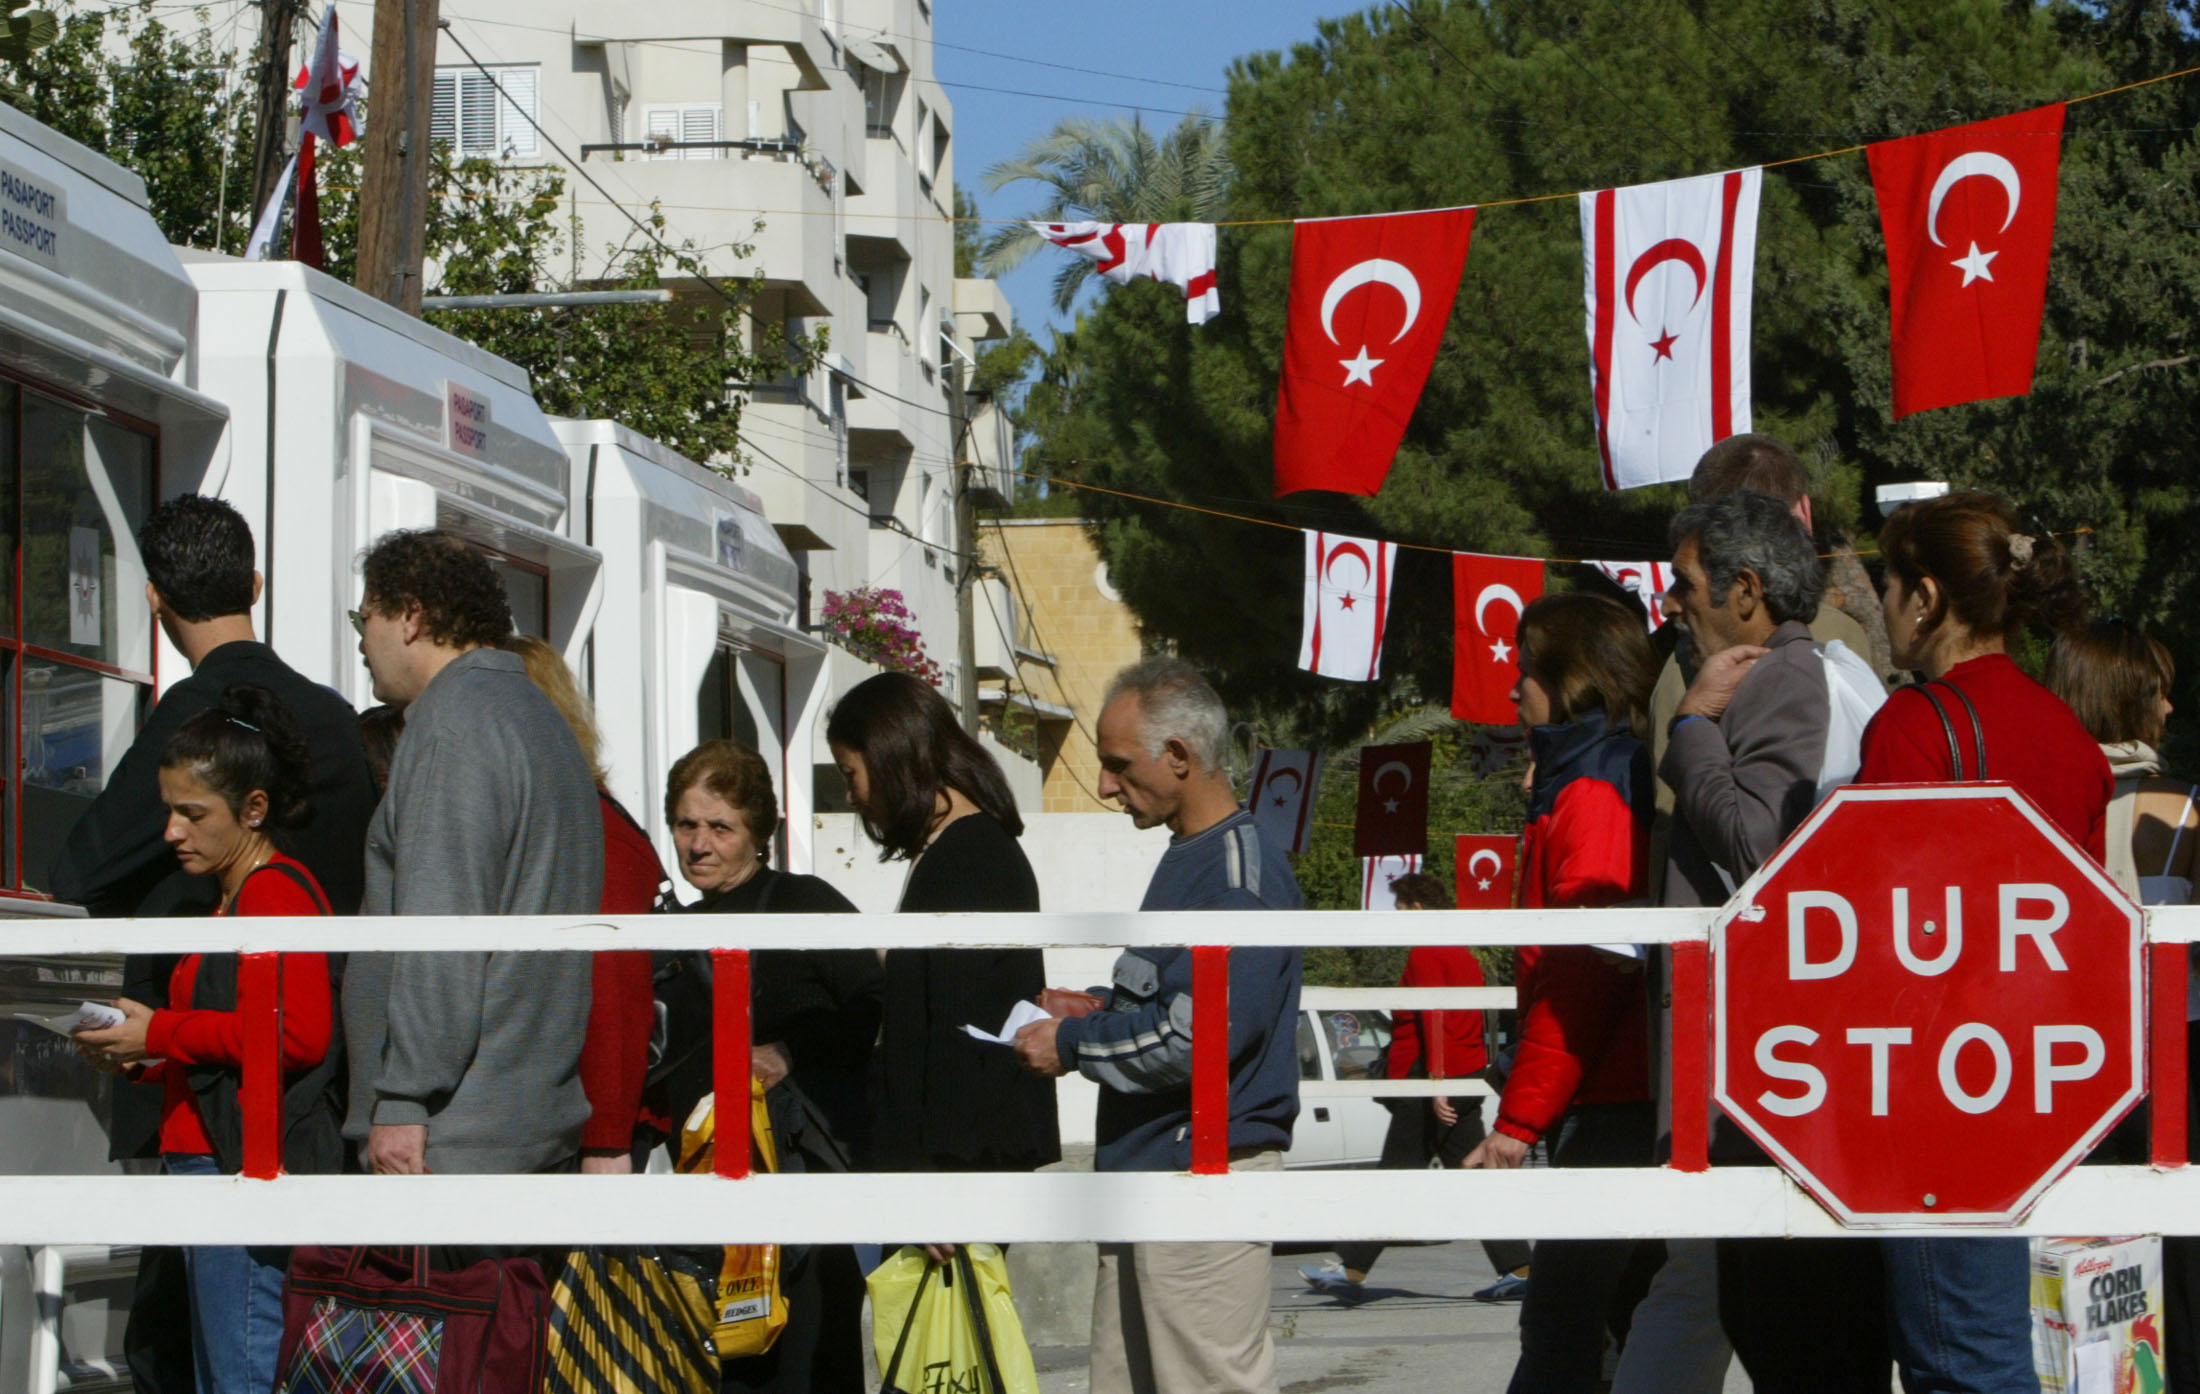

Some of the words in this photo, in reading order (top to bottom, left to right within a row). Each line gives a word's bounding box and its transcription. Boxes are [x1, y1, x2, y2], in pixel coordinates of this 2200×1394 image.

[1, 170, 55, 220] PASAPORT
[2, 207, 56, 256] PASSPORT
[453, 392, 485, 423] PASAPORT
[455, 421, 487, 451] PASSPORT
[1788, 883, 2070, 980] DUR
[1754, 1023, 2105, 1117] STOP
[2089, 1264, 2142, 1302] CORN
[2086, 1291, 2148, 1331] FLAKES
